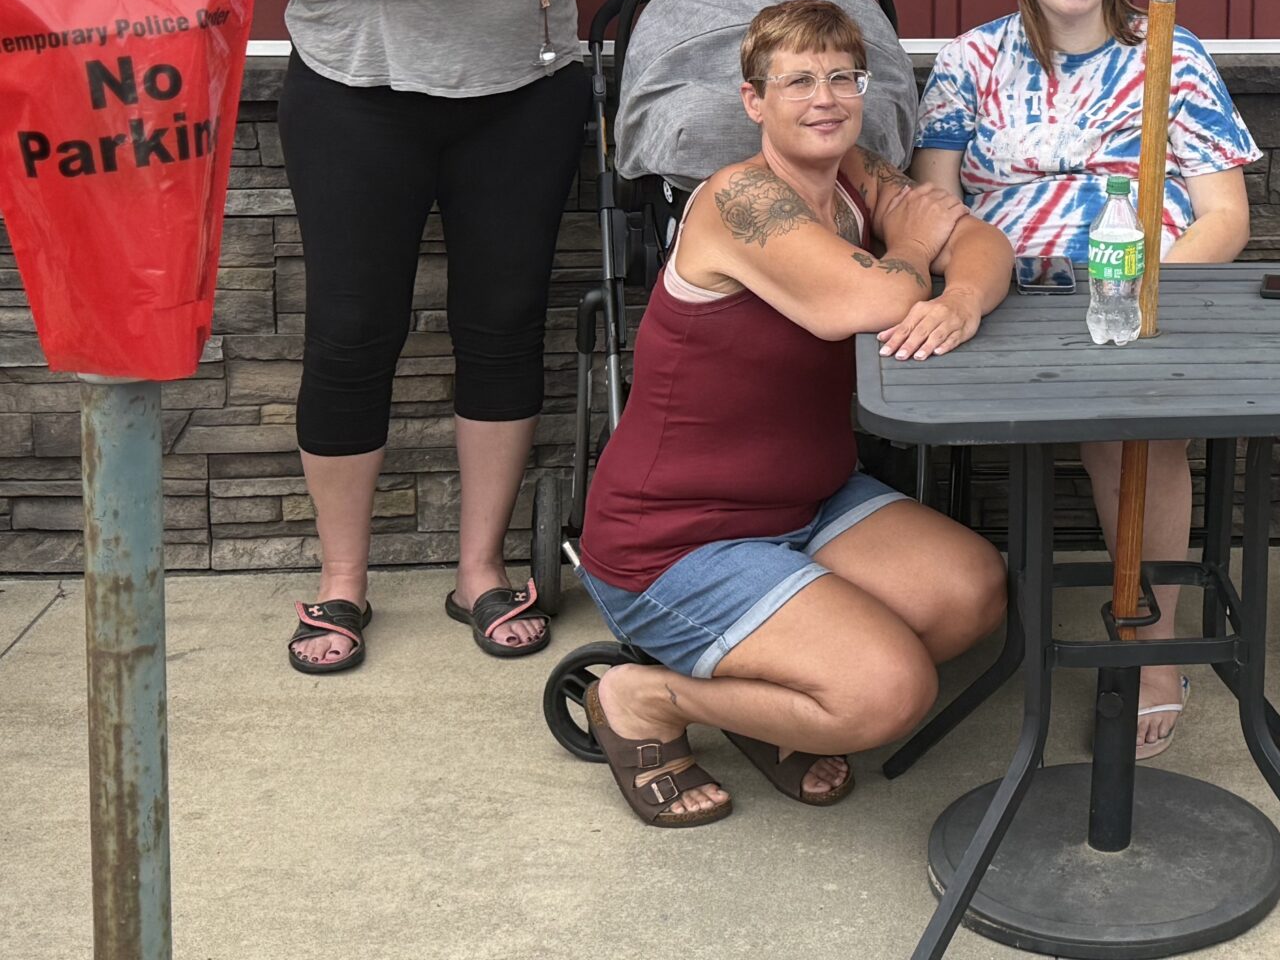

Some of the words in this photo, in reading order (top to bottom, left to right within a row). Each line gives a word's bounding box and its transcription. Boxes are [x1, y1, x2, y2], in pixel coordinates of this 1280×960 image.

[0, 26, 107, 54] emporary
[115, 16, 190, 39] Police
[86, 55, 183, 110] No
[17, 111, 220, 178] Parkin
[1089, 242, 1124, 265] rite
